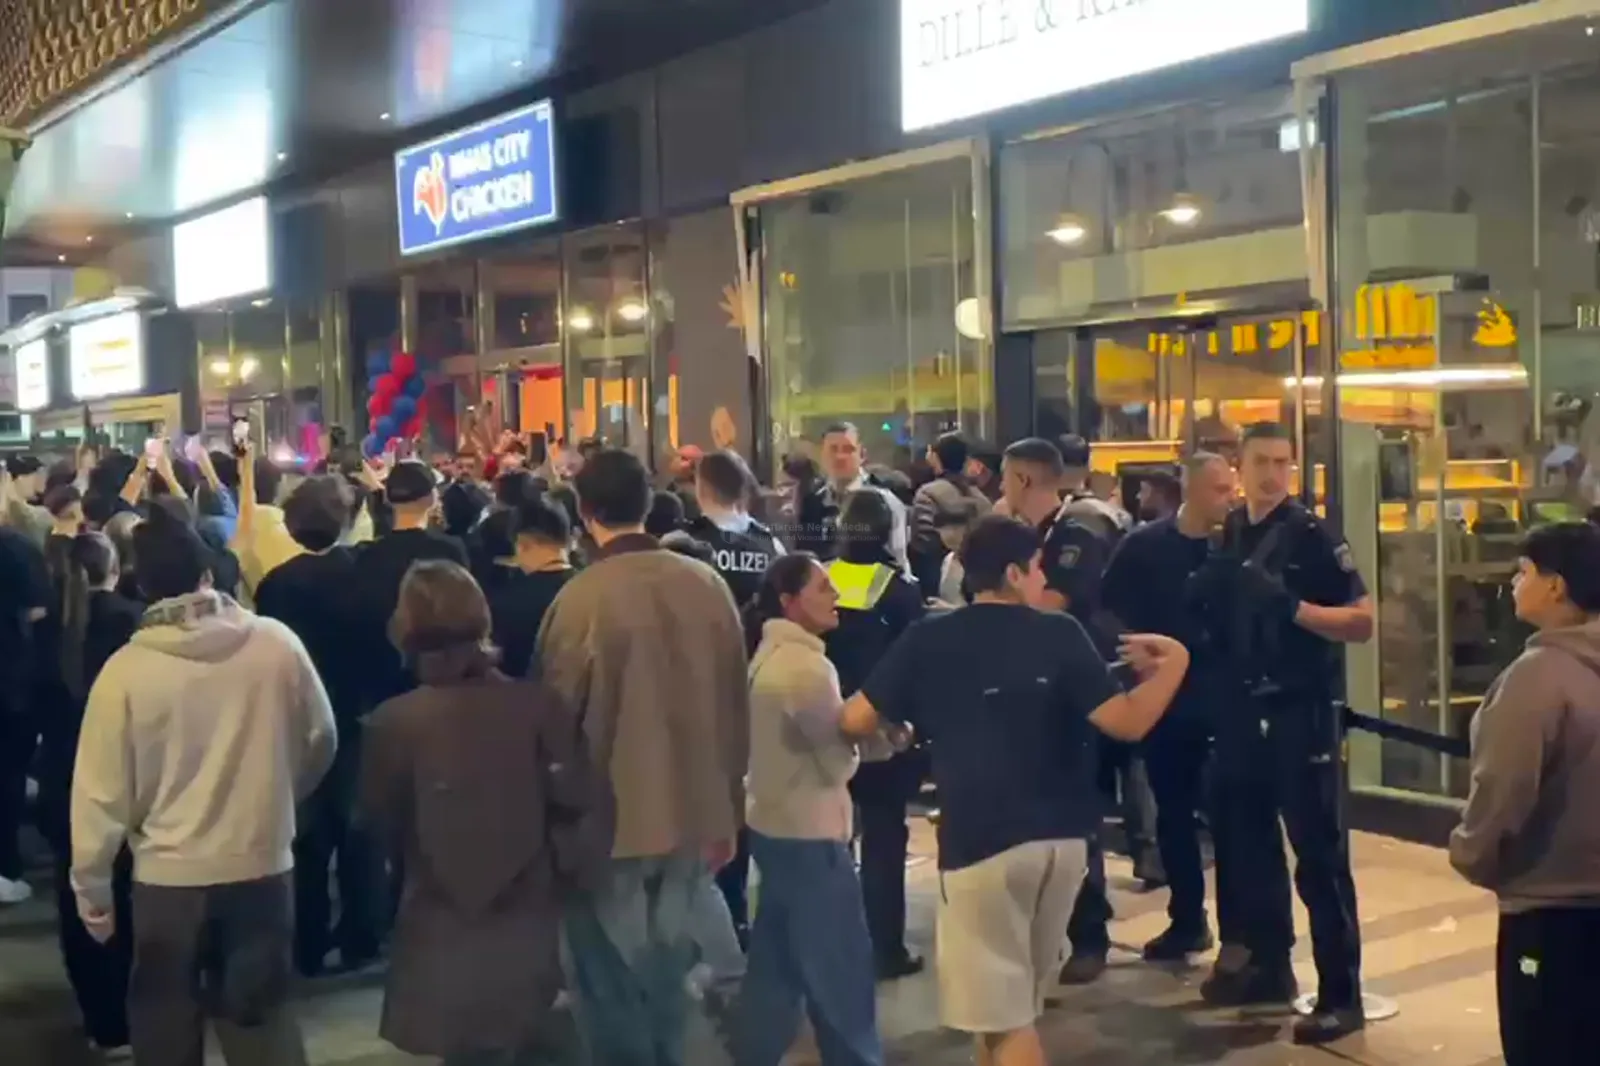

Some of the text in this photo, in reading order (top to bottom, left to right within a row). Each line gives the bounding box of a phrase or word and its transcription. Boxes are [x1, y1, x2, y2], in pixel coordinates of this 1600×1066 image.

[493, 129, 533, 167] CITY
[451, 170, 534, 223] CHICKEN
[712, 549, 769, 572] OLIZEI
